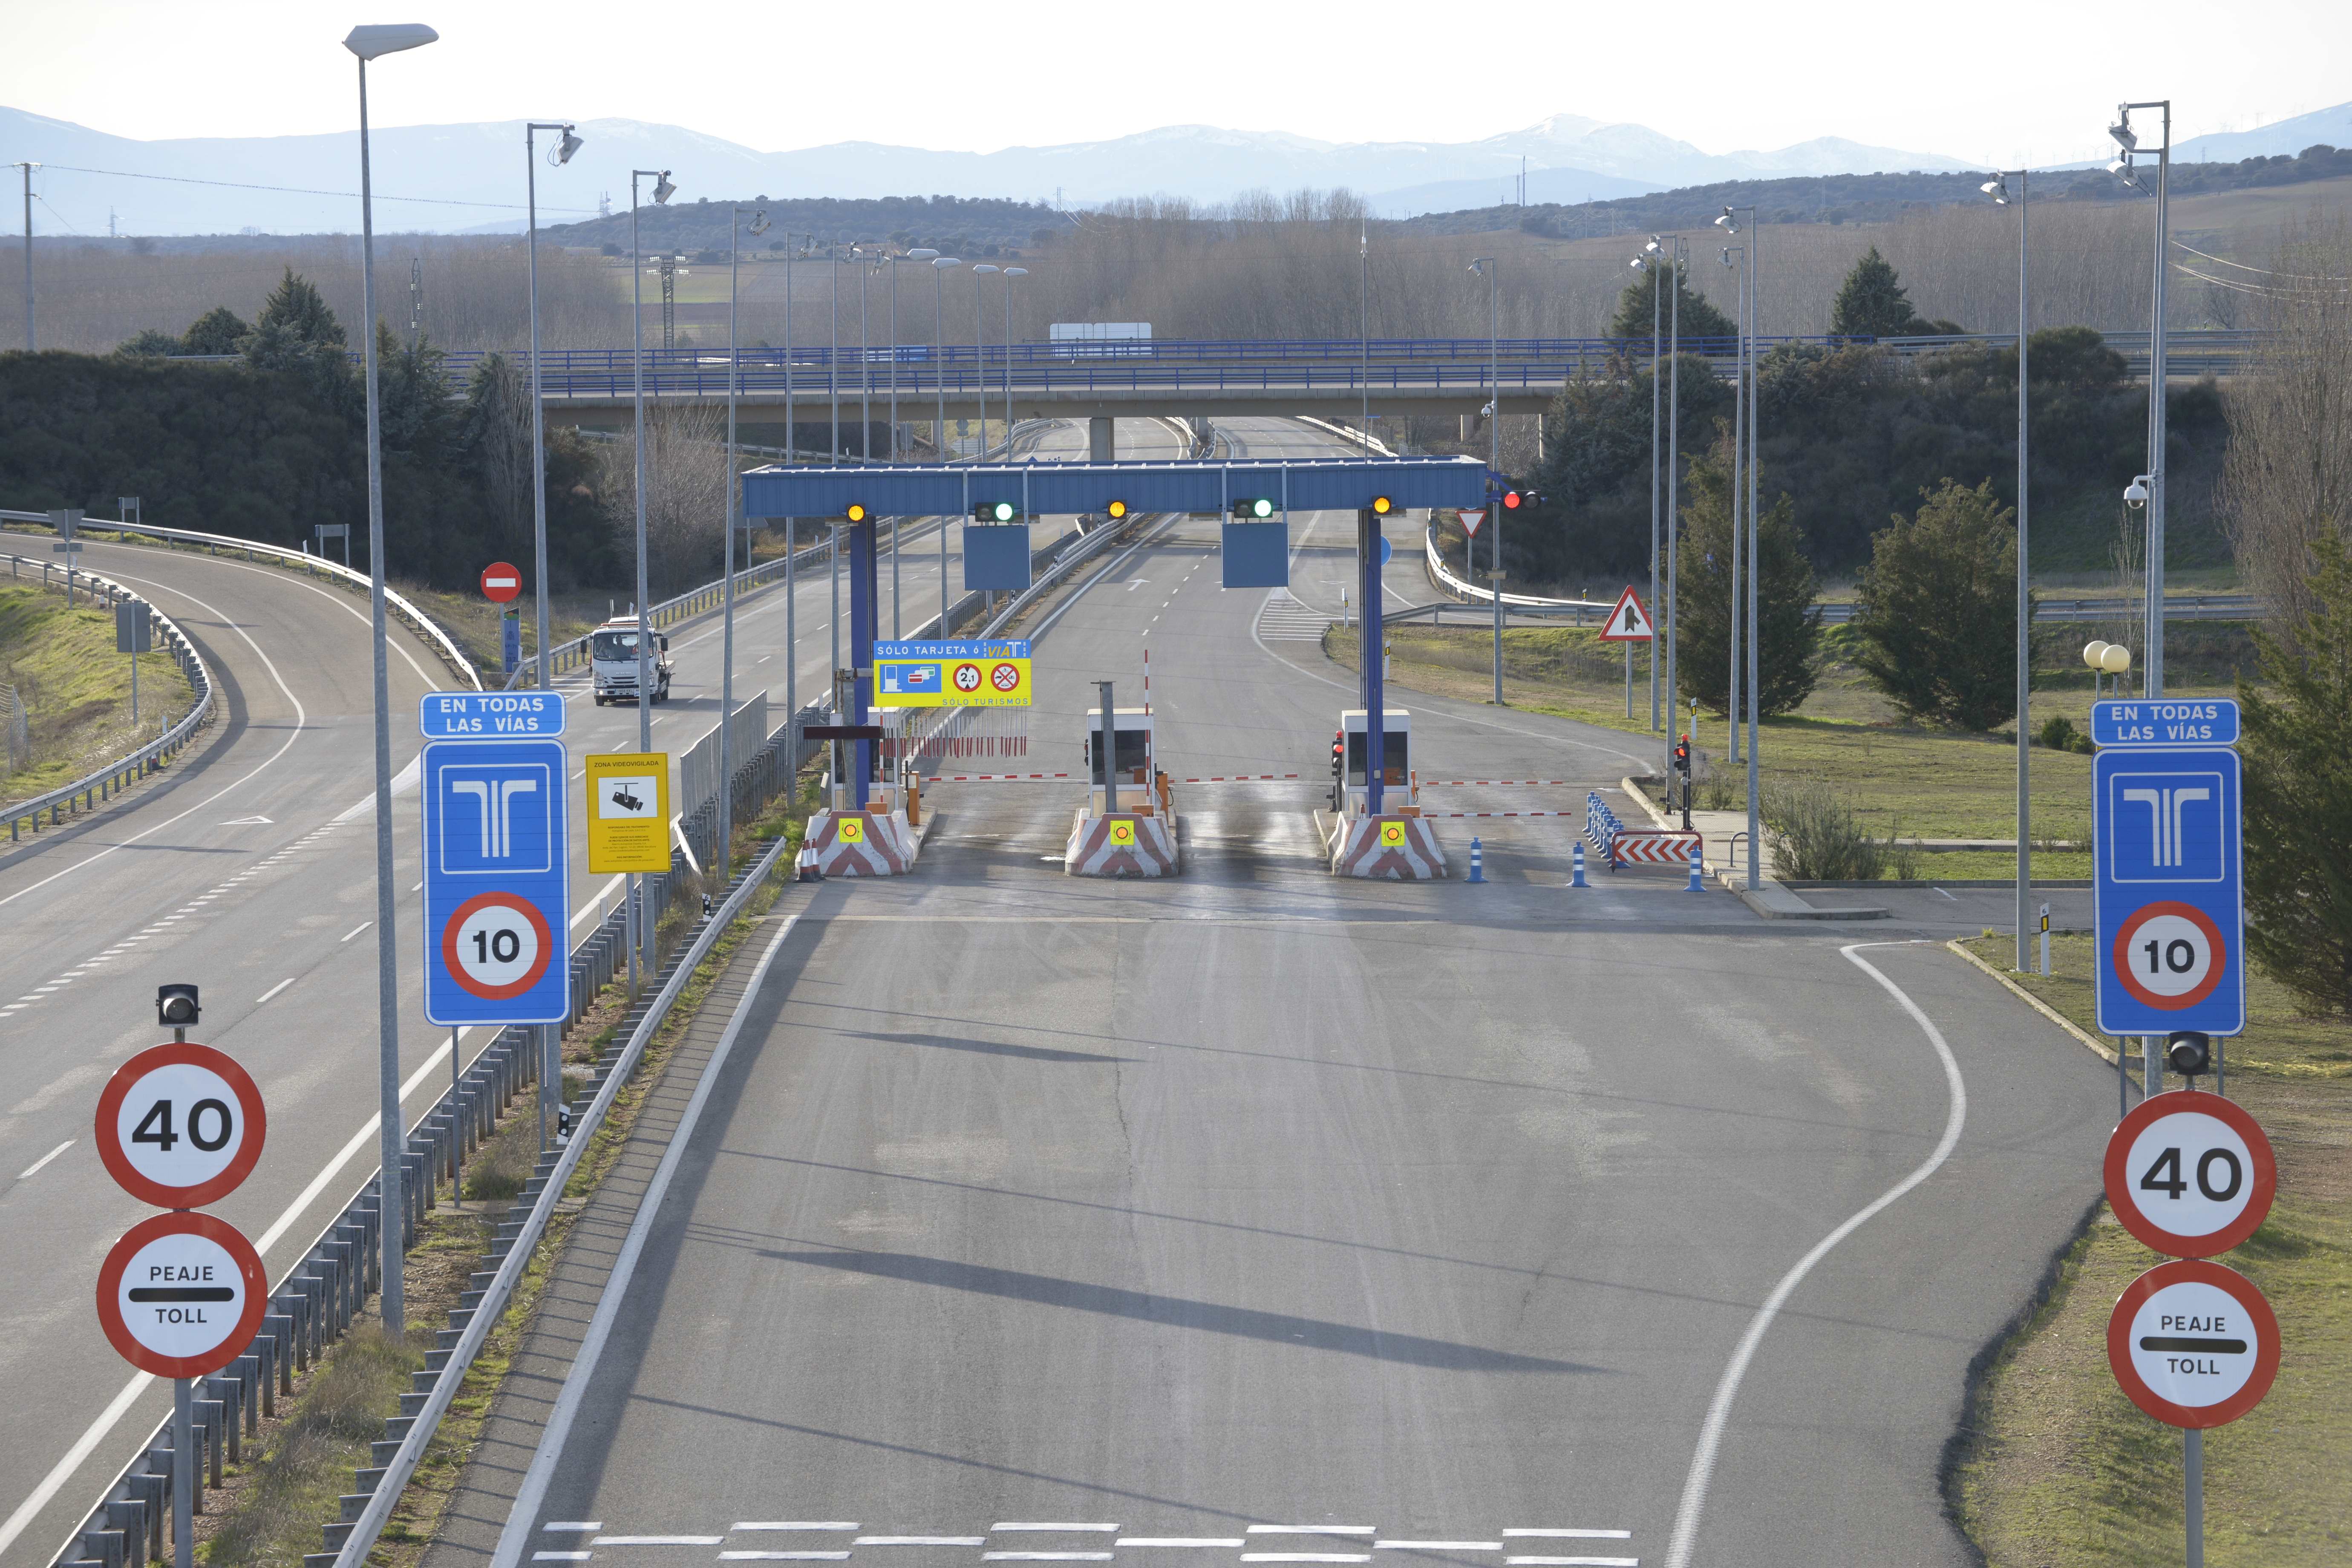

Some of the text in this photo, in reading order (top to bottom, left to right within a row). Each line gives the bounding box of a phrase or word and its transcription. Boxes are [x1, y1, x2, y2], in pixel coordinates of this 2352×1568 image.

[877, 645, 908, 655] SÓLO
[915, 646, 967, 654] TARJETA
[961, 672, 975, 682] 2,1
[441, 698, 544, 712] EN TODAS
[2112, 706, 2218, 721] EN TODAS
[447, 714, 539, 732] LAS VÍAS
[2118, 723, 2212, 740] LAS VÍAS
[473, 929, 520, 963] 10
[2144, 939, 2195, 974] 10
[132, 1098, 232, 1152] 40
[2140, 1147, 2242, 1202] 40
[150, 1266, 213, 1281] PEAJE
[156, 1309, 207, 1323] TOLL
[2161, 1315, 2225, 1332] PEAJE
[2167, 1359, 2220, 1375] TOLL
